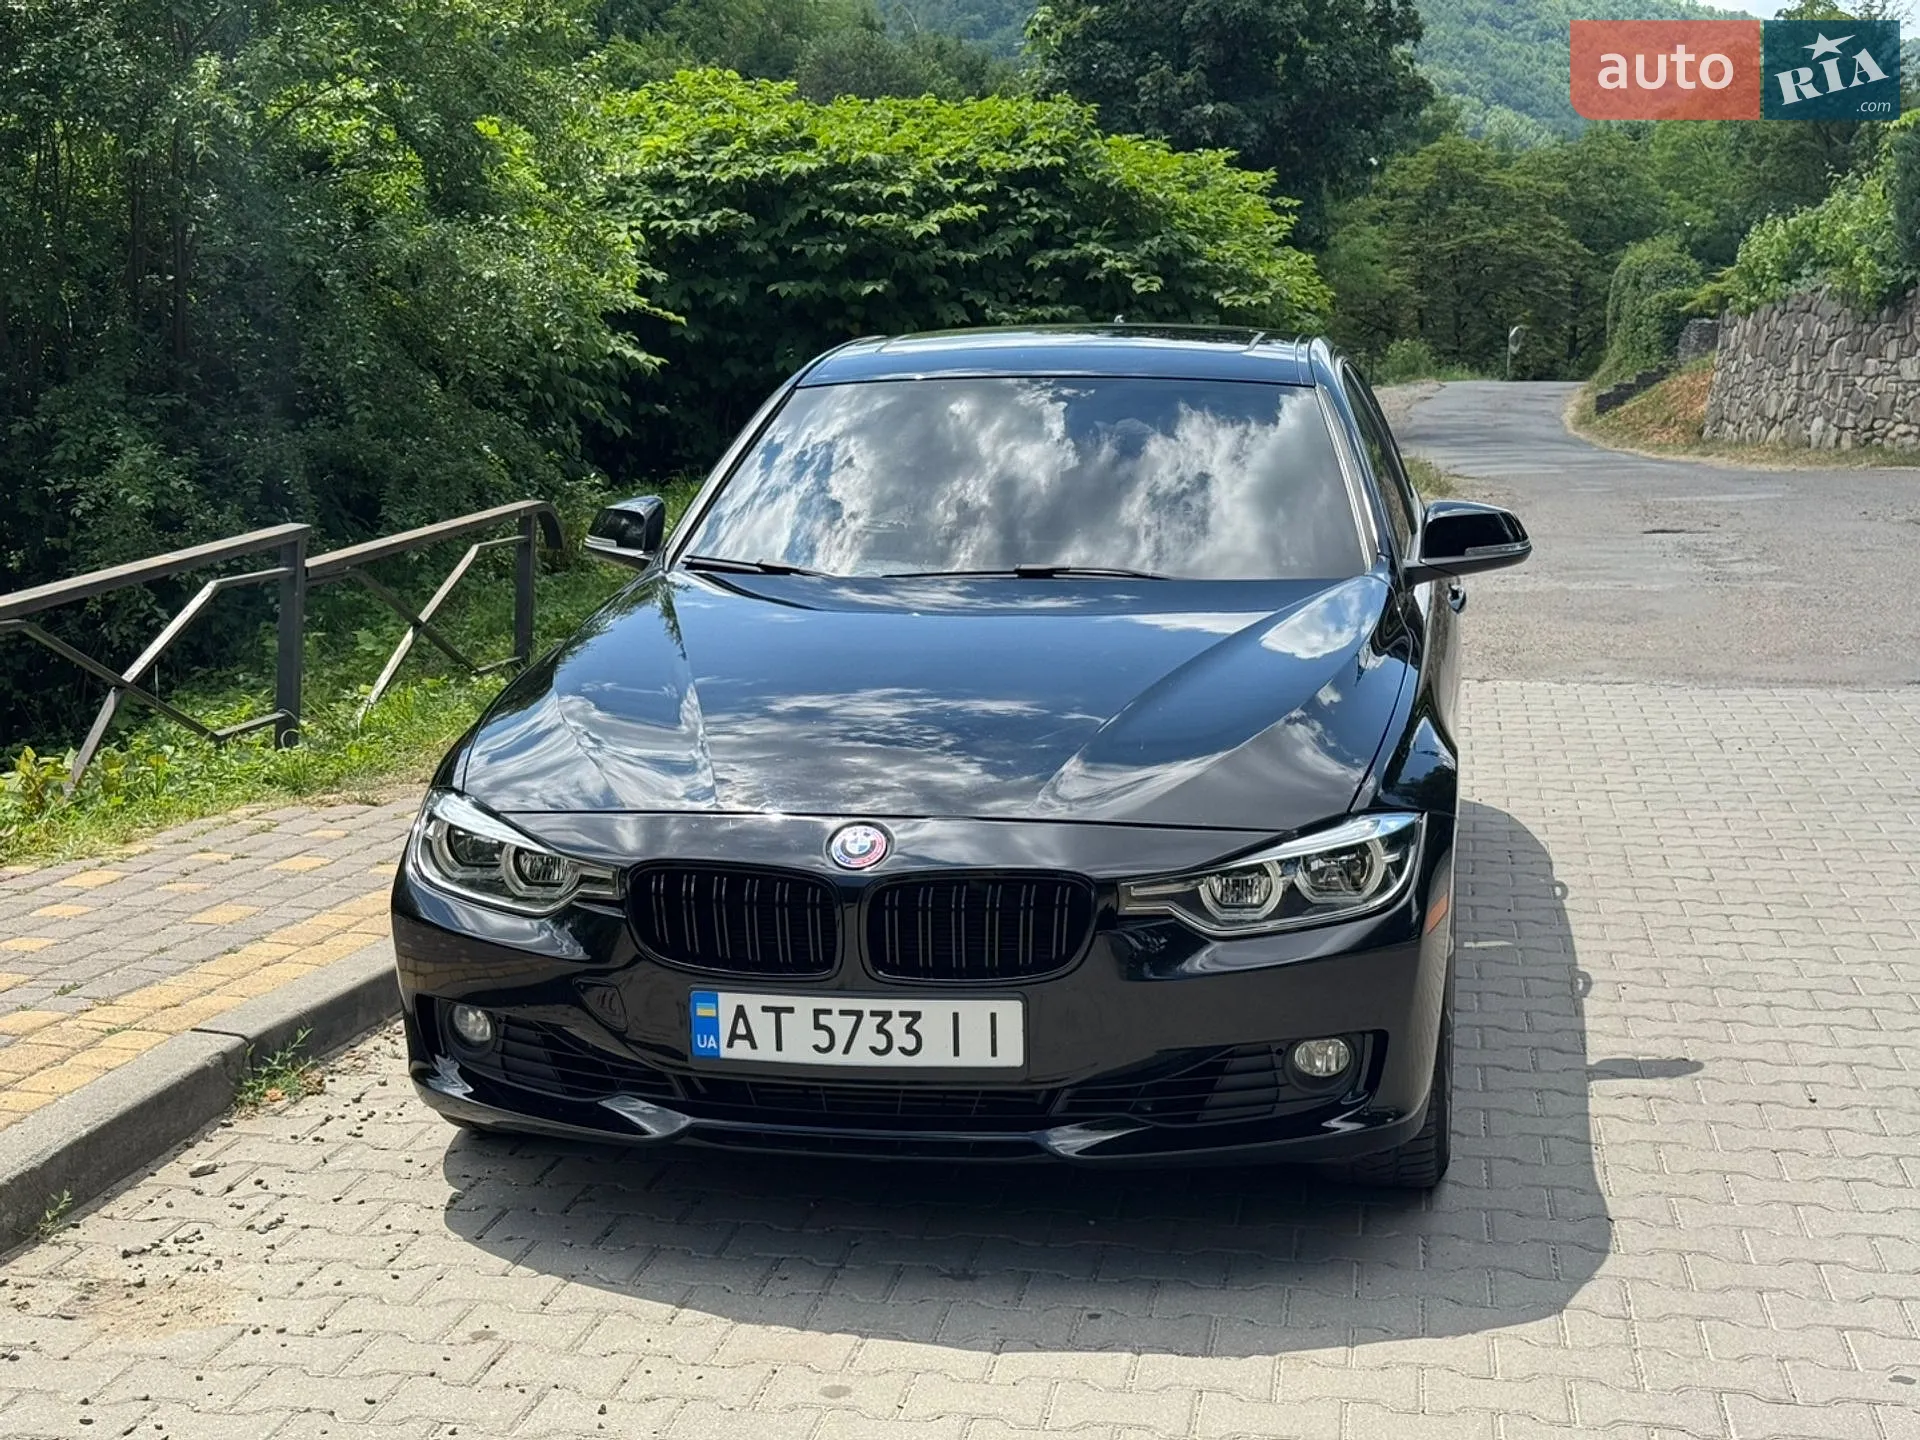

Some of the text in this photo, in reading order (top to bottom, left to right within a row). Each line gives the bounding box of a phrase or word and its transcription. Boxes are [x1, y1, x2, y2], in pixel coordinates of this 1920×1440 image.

[696, 1034, 718, 1049] UA
[726, 1004, 795, 1052] AT
[811, 1008, 923, 1057] 5733
